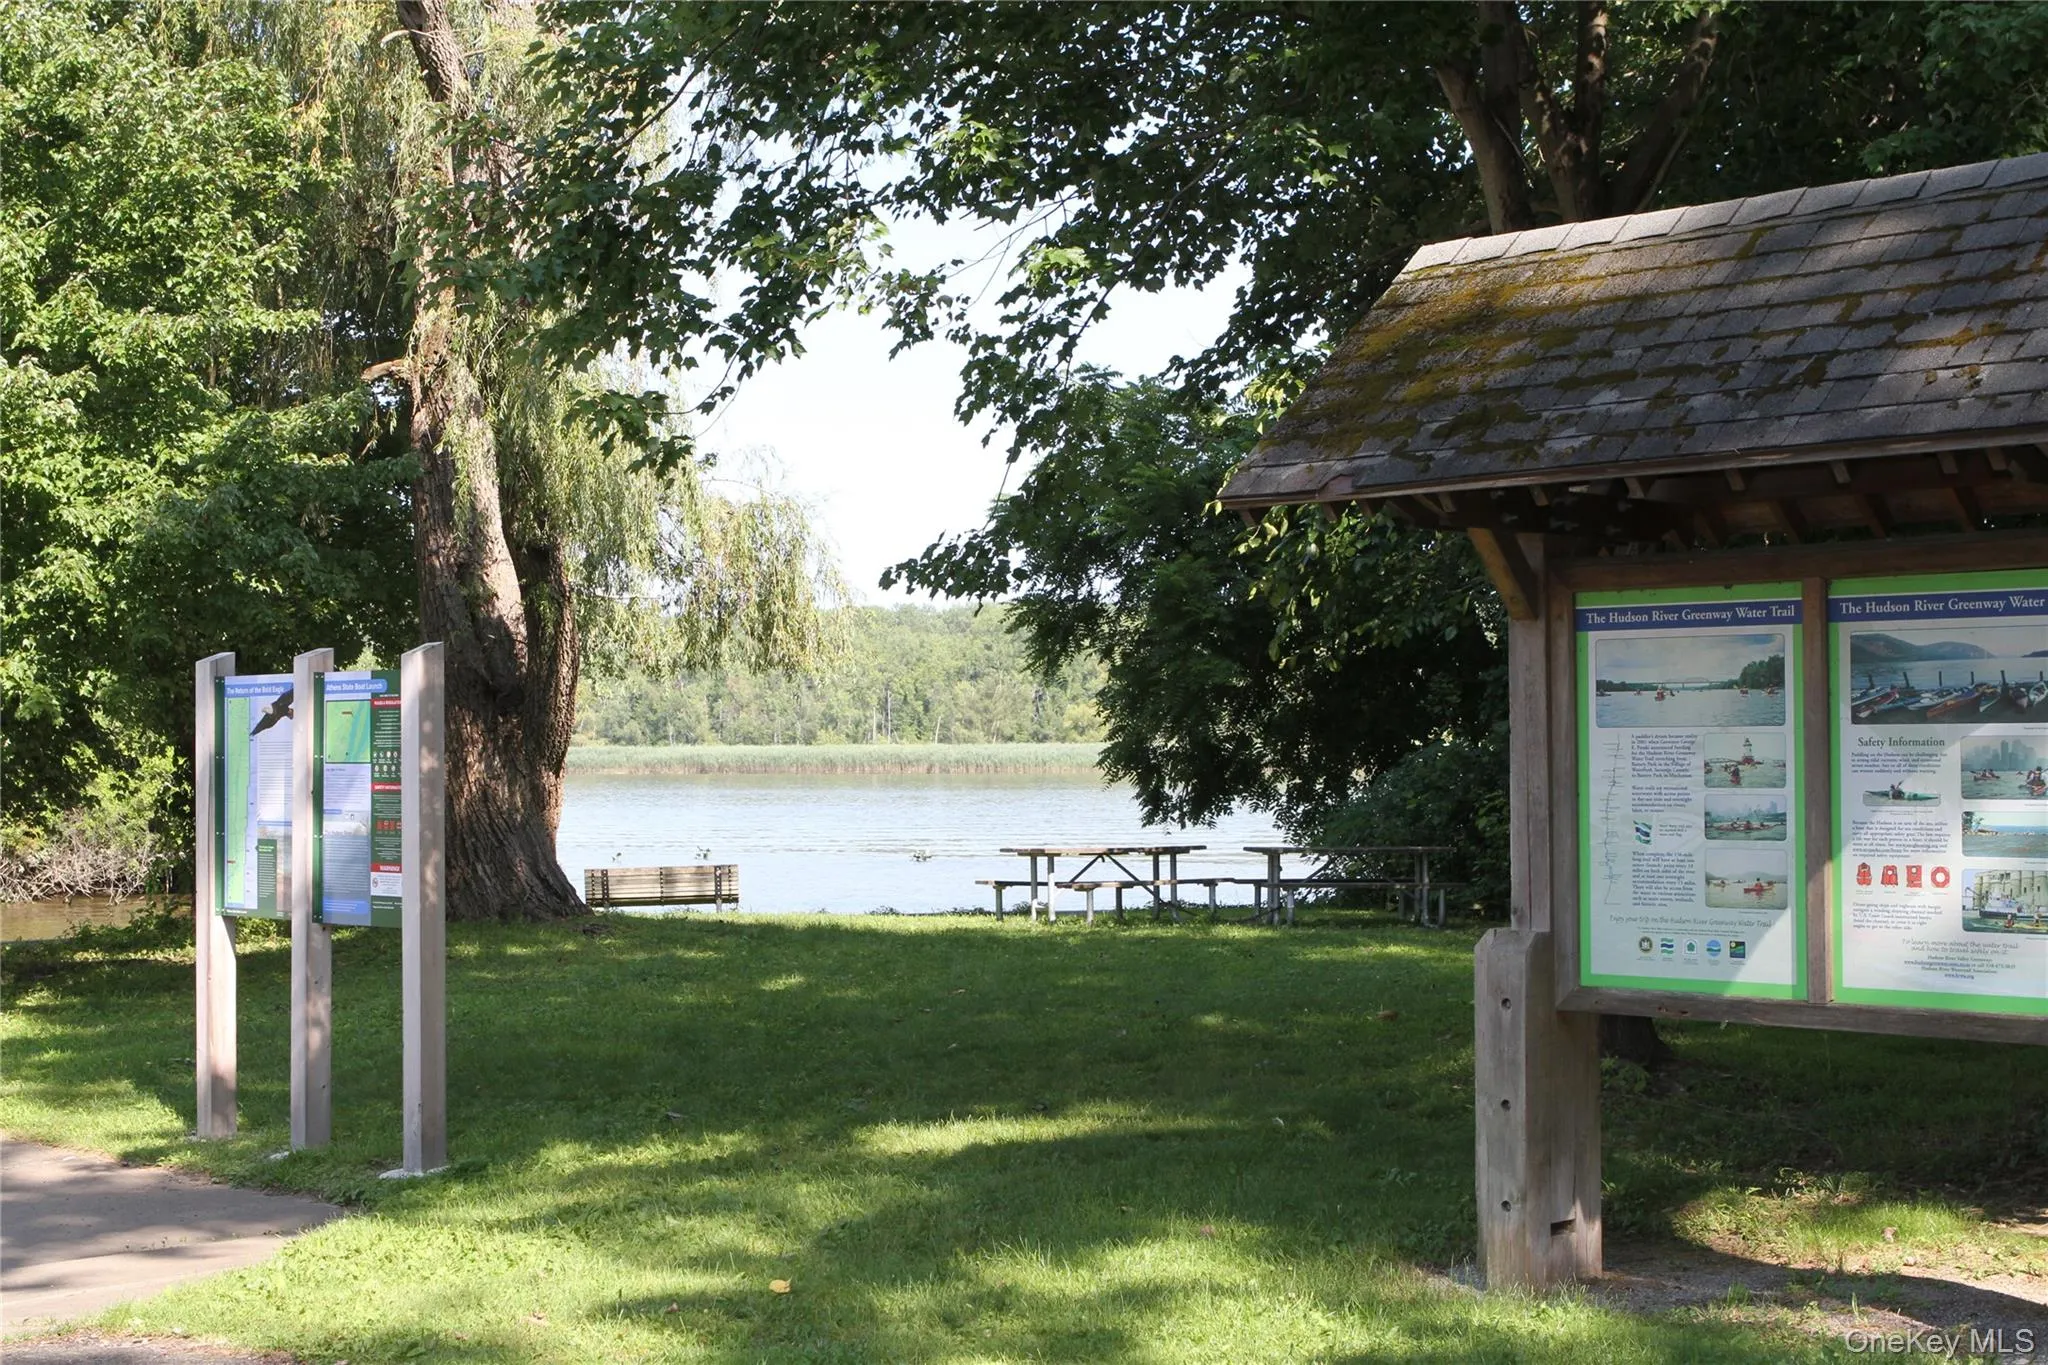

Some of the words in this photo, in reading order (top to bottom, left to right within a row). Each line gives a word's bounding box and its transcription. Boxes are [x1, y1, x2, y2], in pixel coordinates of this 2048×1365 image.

[1840, 602, 1862, 614] The
[1865, 600, 1910, 613] Hudson
[1914, 598, 1945, 612] River
[1948, 597, 2006, 612] Greenway
[2009, 595, 2045, 608] Water
[1586, 613, 1606, 625] The
[1609, 611, 1648, 623] Hudson
[1652, 609, 1679, 622] River
[1682, 608, 1733, 624] Greenway
[1735, 606, 1767, 619] Water
[1769, 604, 1795, 618] Trail
[1857, 736, 1886, 749] Safety
[1888, 736, 1945, 747] Information
